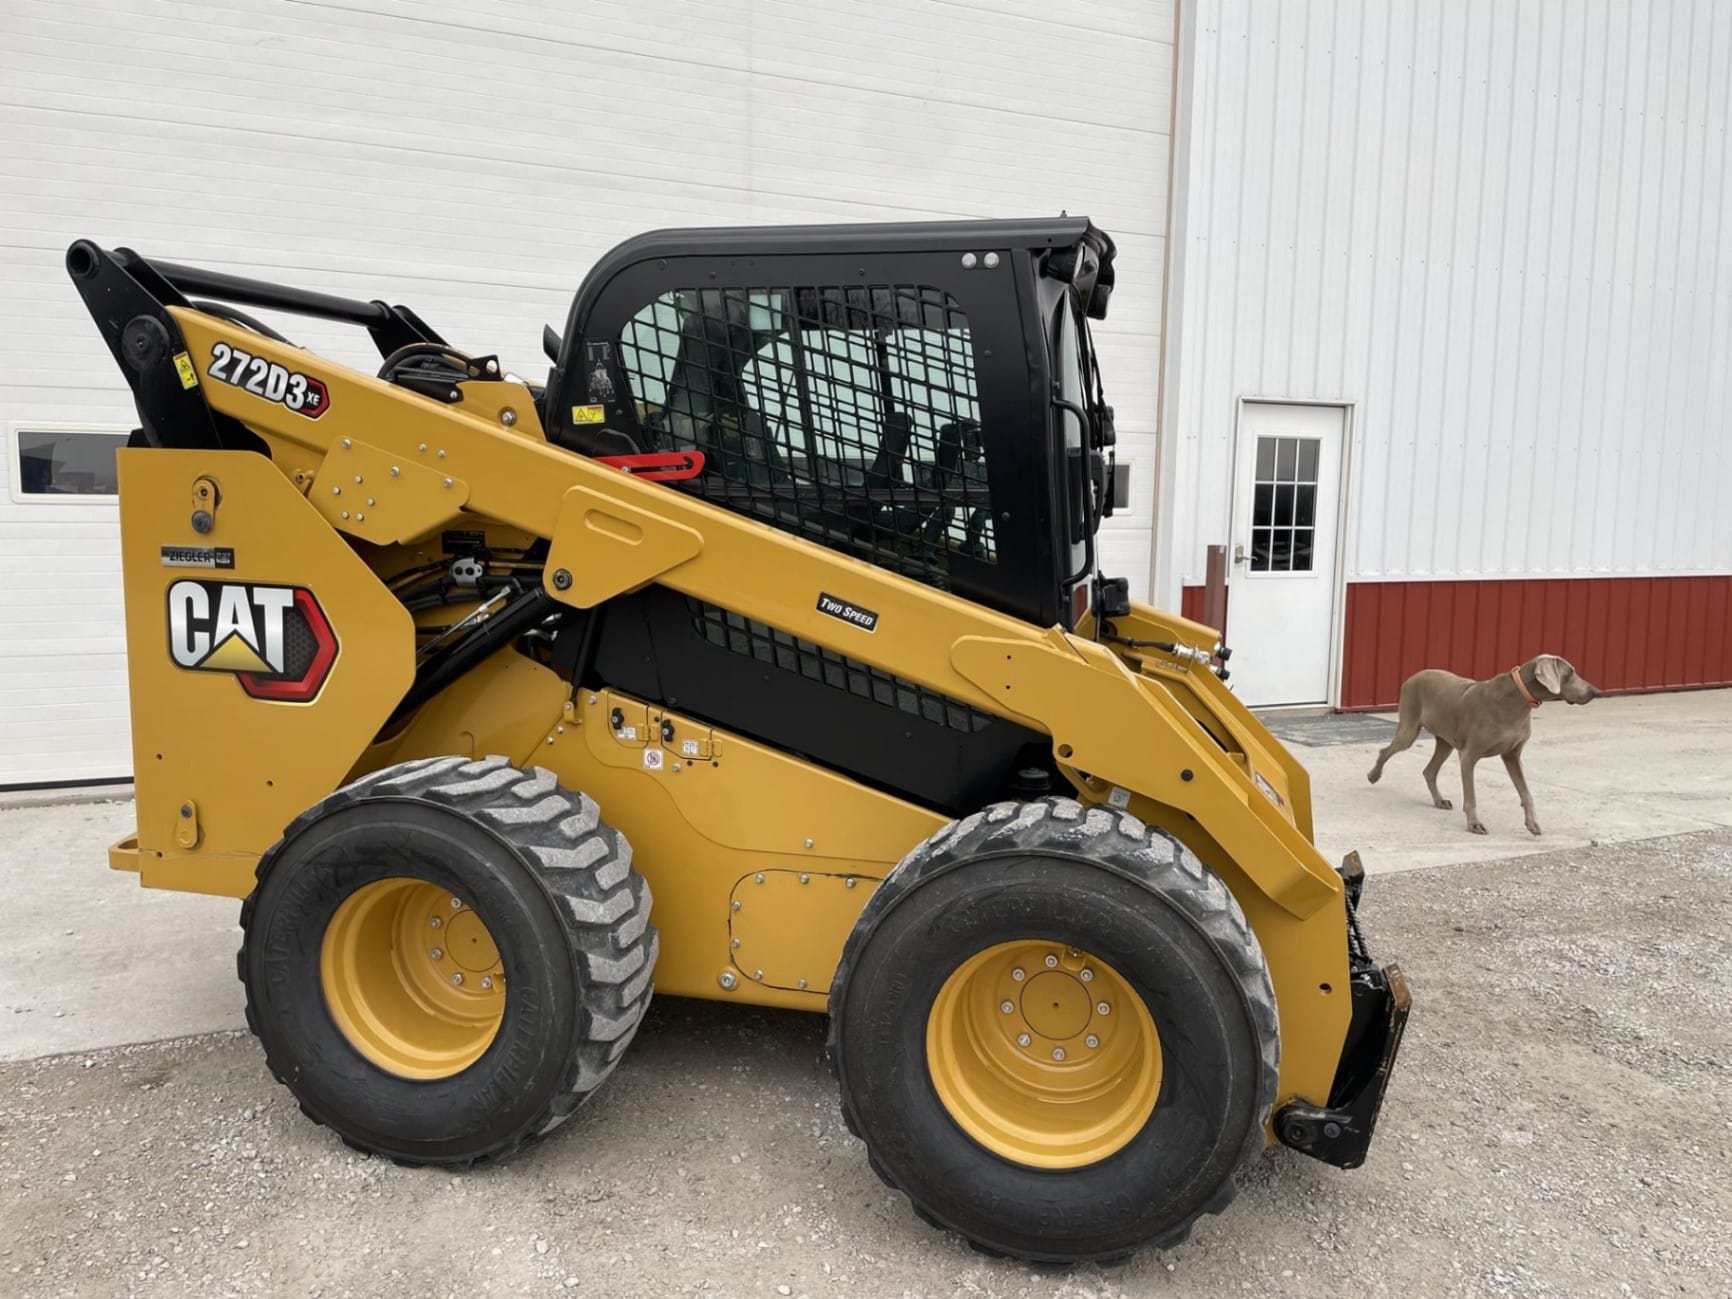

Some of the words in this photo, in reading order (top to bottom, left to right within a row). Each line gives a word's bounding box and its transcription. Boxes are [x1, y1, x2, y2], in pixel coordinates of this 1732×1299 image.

[208, 343, 308, 410] 272D3
[306, 391, 321, 406] XE
[169, 551, 212, 563] ZIEGLER
[169, 581, 295, 673] CAT
